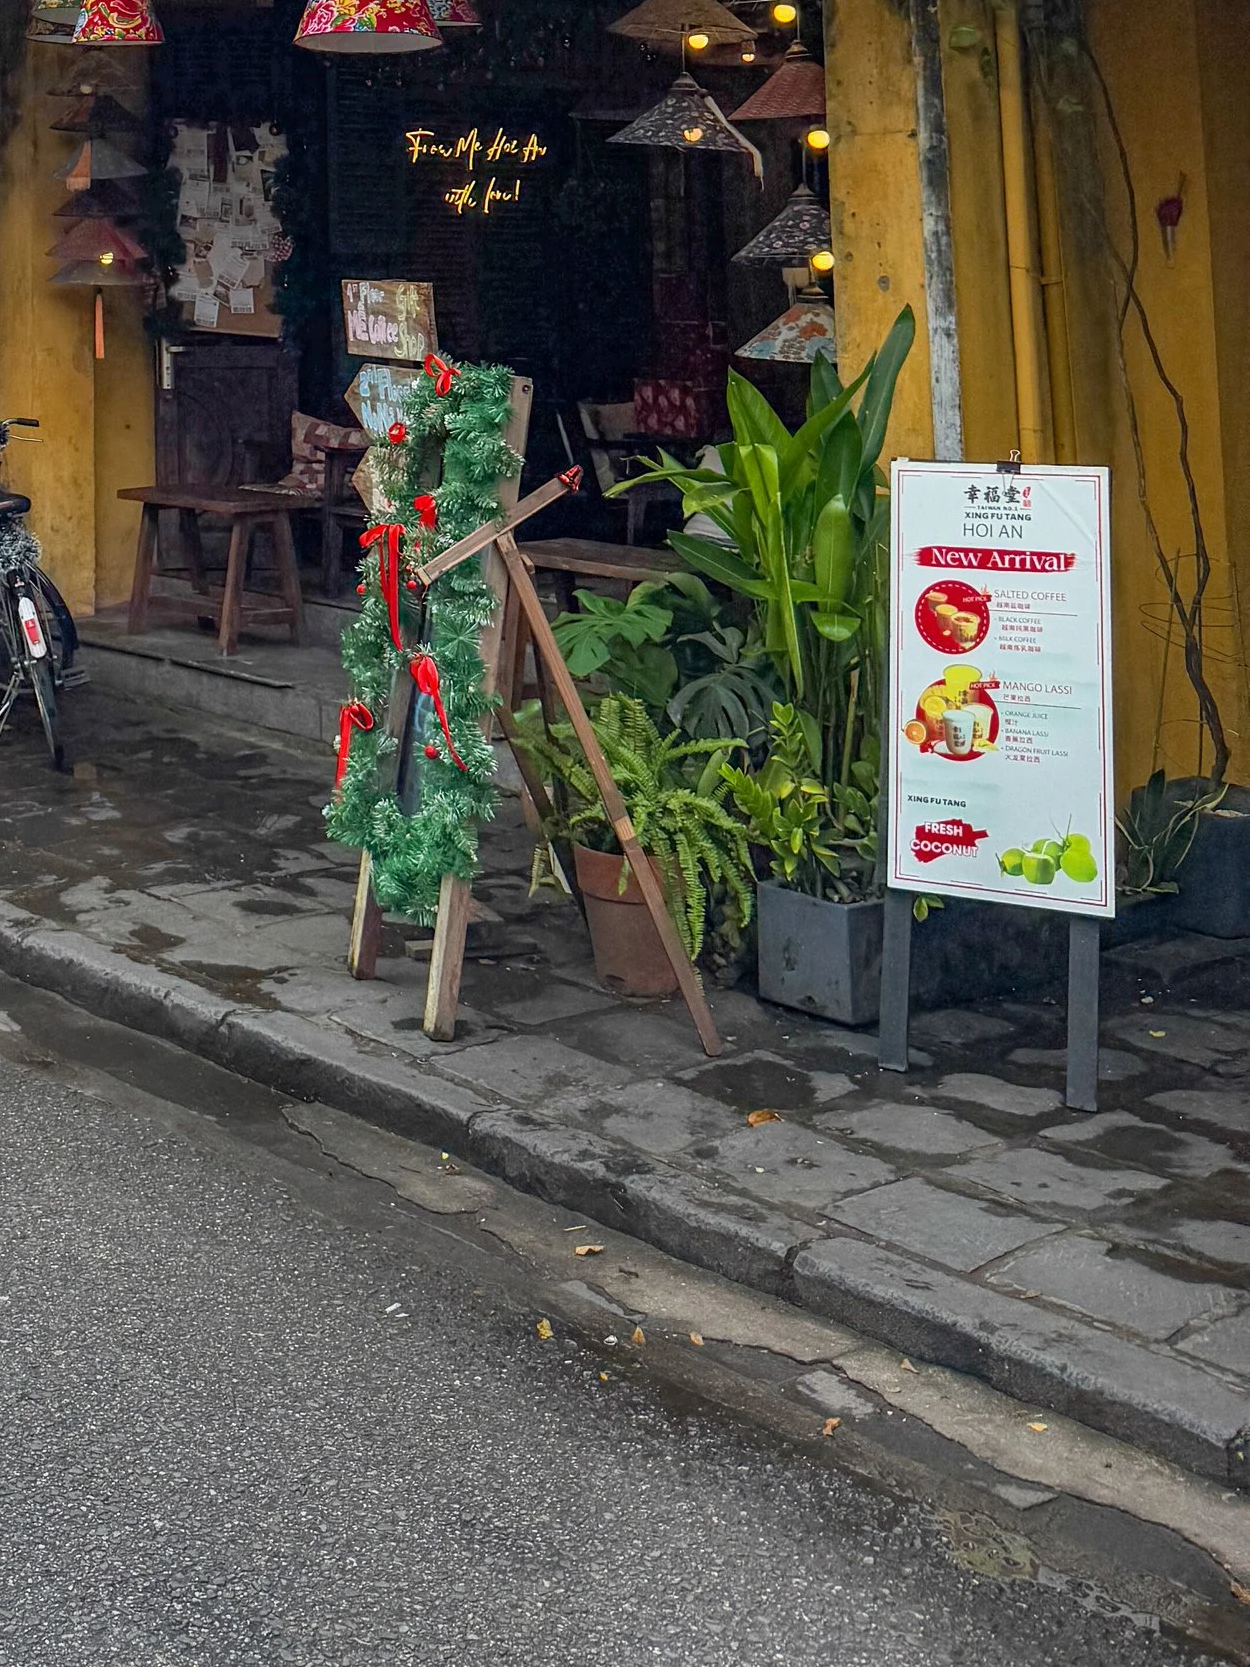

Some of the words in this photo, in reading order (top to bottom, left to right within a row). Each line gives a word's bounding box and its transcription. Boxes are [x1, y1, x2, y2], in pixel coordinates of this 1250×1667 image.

[456, 128, 483, 170] Me
[521, 133, 547, 162] An
[964, 484, 1021, 504] 幸福堂
[965, 511, 989, 520] XING
[991, 512, 1003, 520] FU
[1004, 513, 1032, 521] TANG
[963, 522, 993, 538] HOI
[998, 524, 1023, 539] AN
[931, 547, 983, 566] New
[986, 551, 1066, 572] Arrival
[994, 589, 1029, 600] SALTED
[1030, 592, 1067, 602] COFFEE
[1014, 636, 1036, 644] COFFEE
[1002, 681, 1042, 692] MANGO
[1044, 684, 1072, 695] LASSI
[1005, 710, 1031, 718] ORANGE
[1005, 728, 1031, 736] BANANA
[1005, 745, 1032, 753] DRAGON
[1033, 747, 1050, 755] FRUIT
[1051, 749, 1069, 757] LASSI
[907, 795, 929, 803] XING
[930, 797, 941, 805] FU
[942, 798, 967, 808] TANG
[924, 821, 963, 837] FRESH
[910, 838, 978, 858] COCONUT
